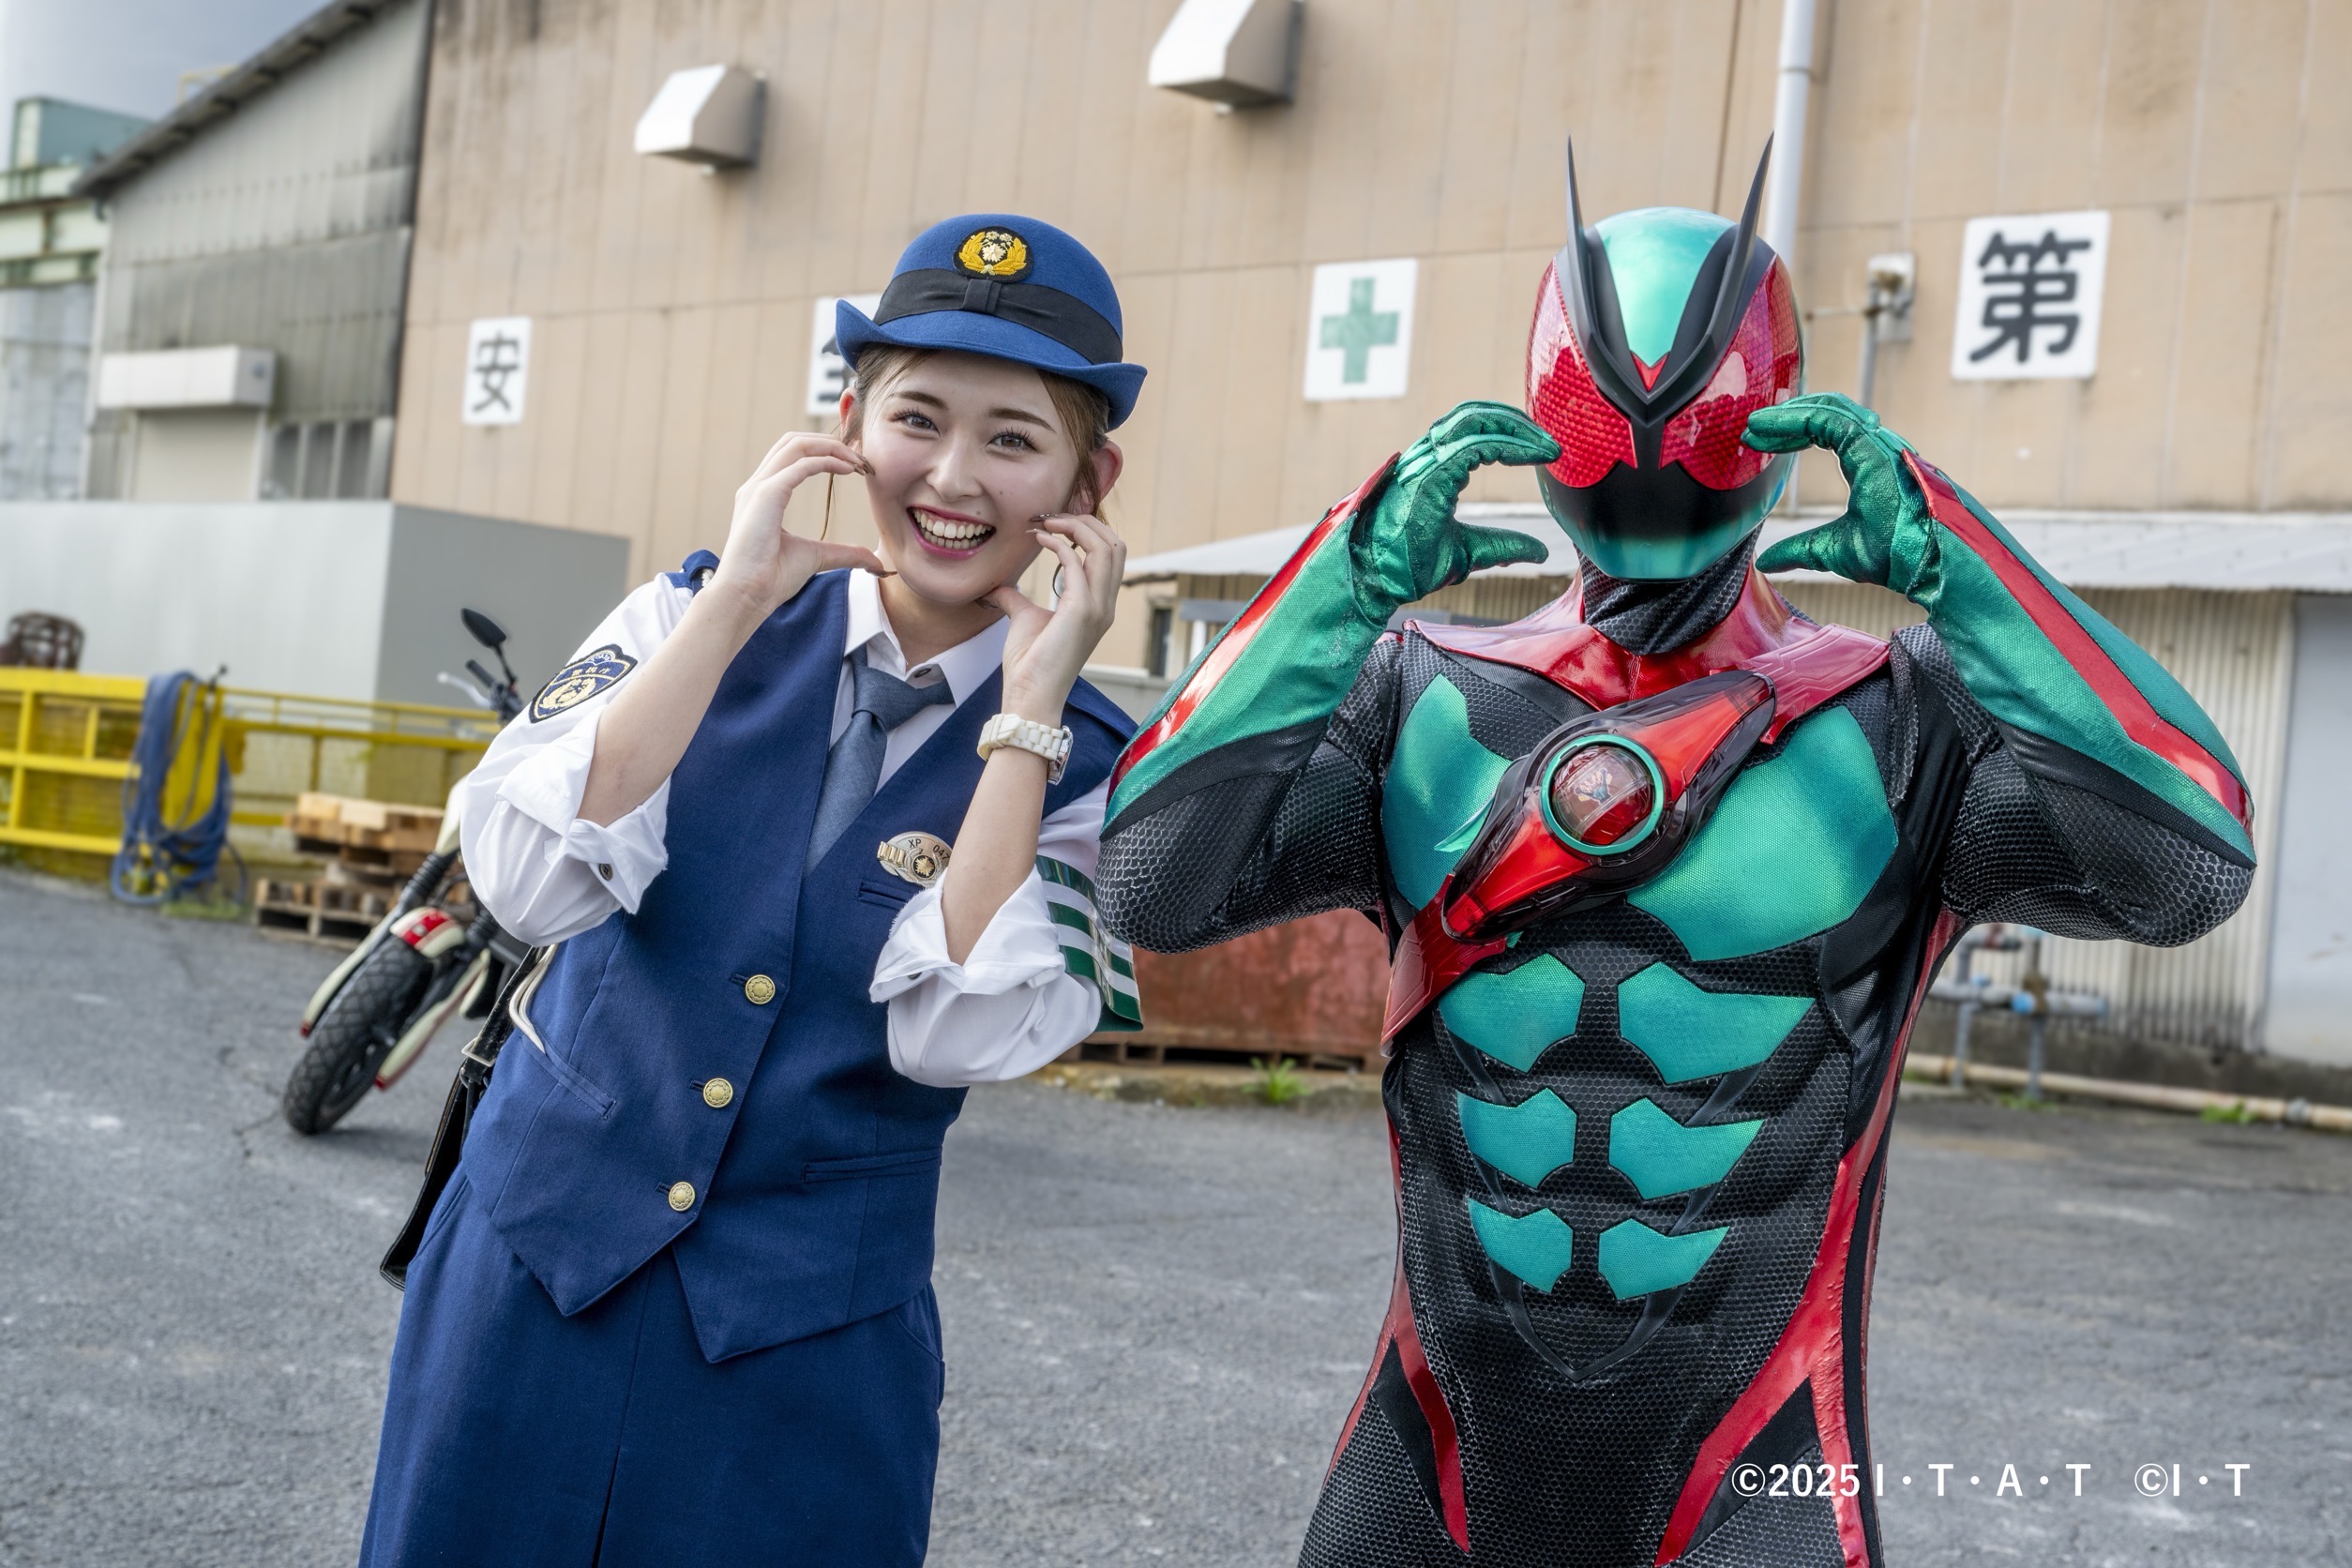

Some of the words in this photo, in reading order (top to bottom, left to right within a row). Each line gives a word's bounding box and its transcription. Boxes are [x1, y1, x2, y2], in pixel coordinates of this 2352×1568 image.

[1970, 230, 2090, 363] 第
[473, 329, 519, 412] 安
[909, 838, 921, 848] XP
